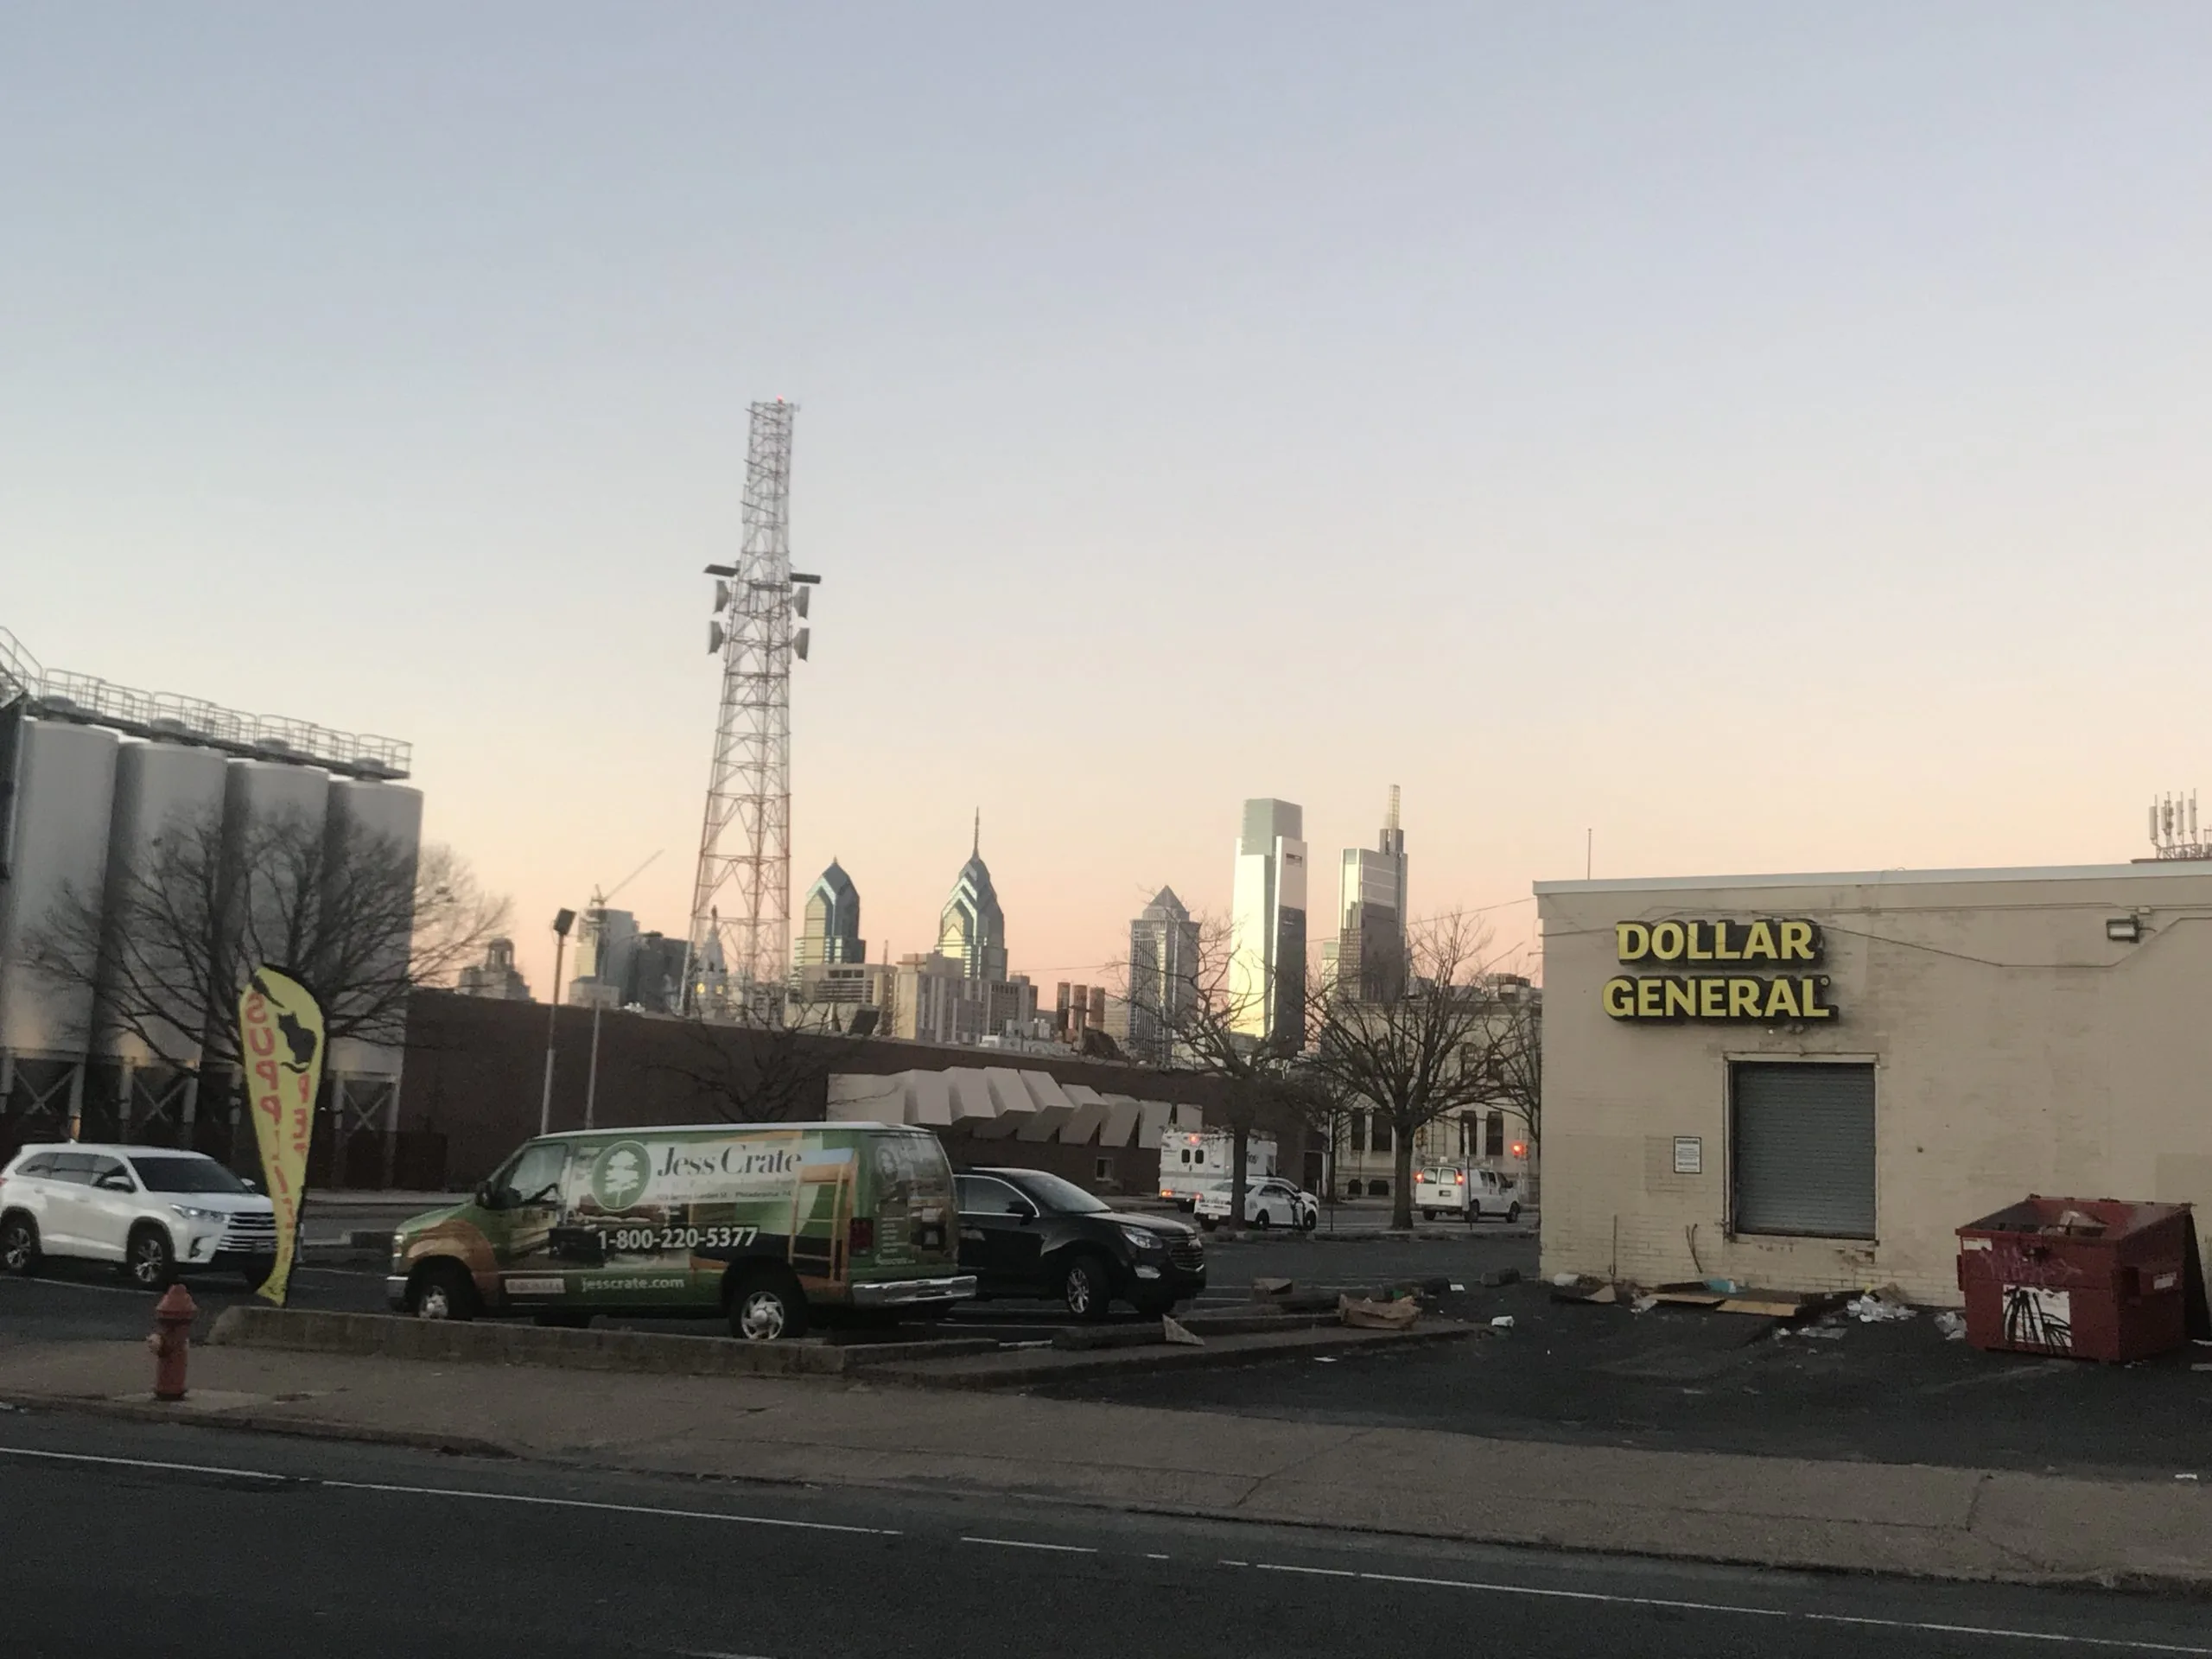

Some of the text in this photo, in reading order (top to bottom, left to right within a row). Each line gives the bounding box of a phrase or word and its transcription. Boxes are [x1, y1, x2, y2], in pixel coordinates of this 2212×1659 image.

[1615, 921, 1815, 961] DOLLAR
[1602, 978, 1830, 1018] GENERAL
[658, 1143, 803, 1176] Jess Crate
[598, 1225, 758, 1250] 1-800-220-5377
[581, 1276, 686, 1293] jesscrate.com
